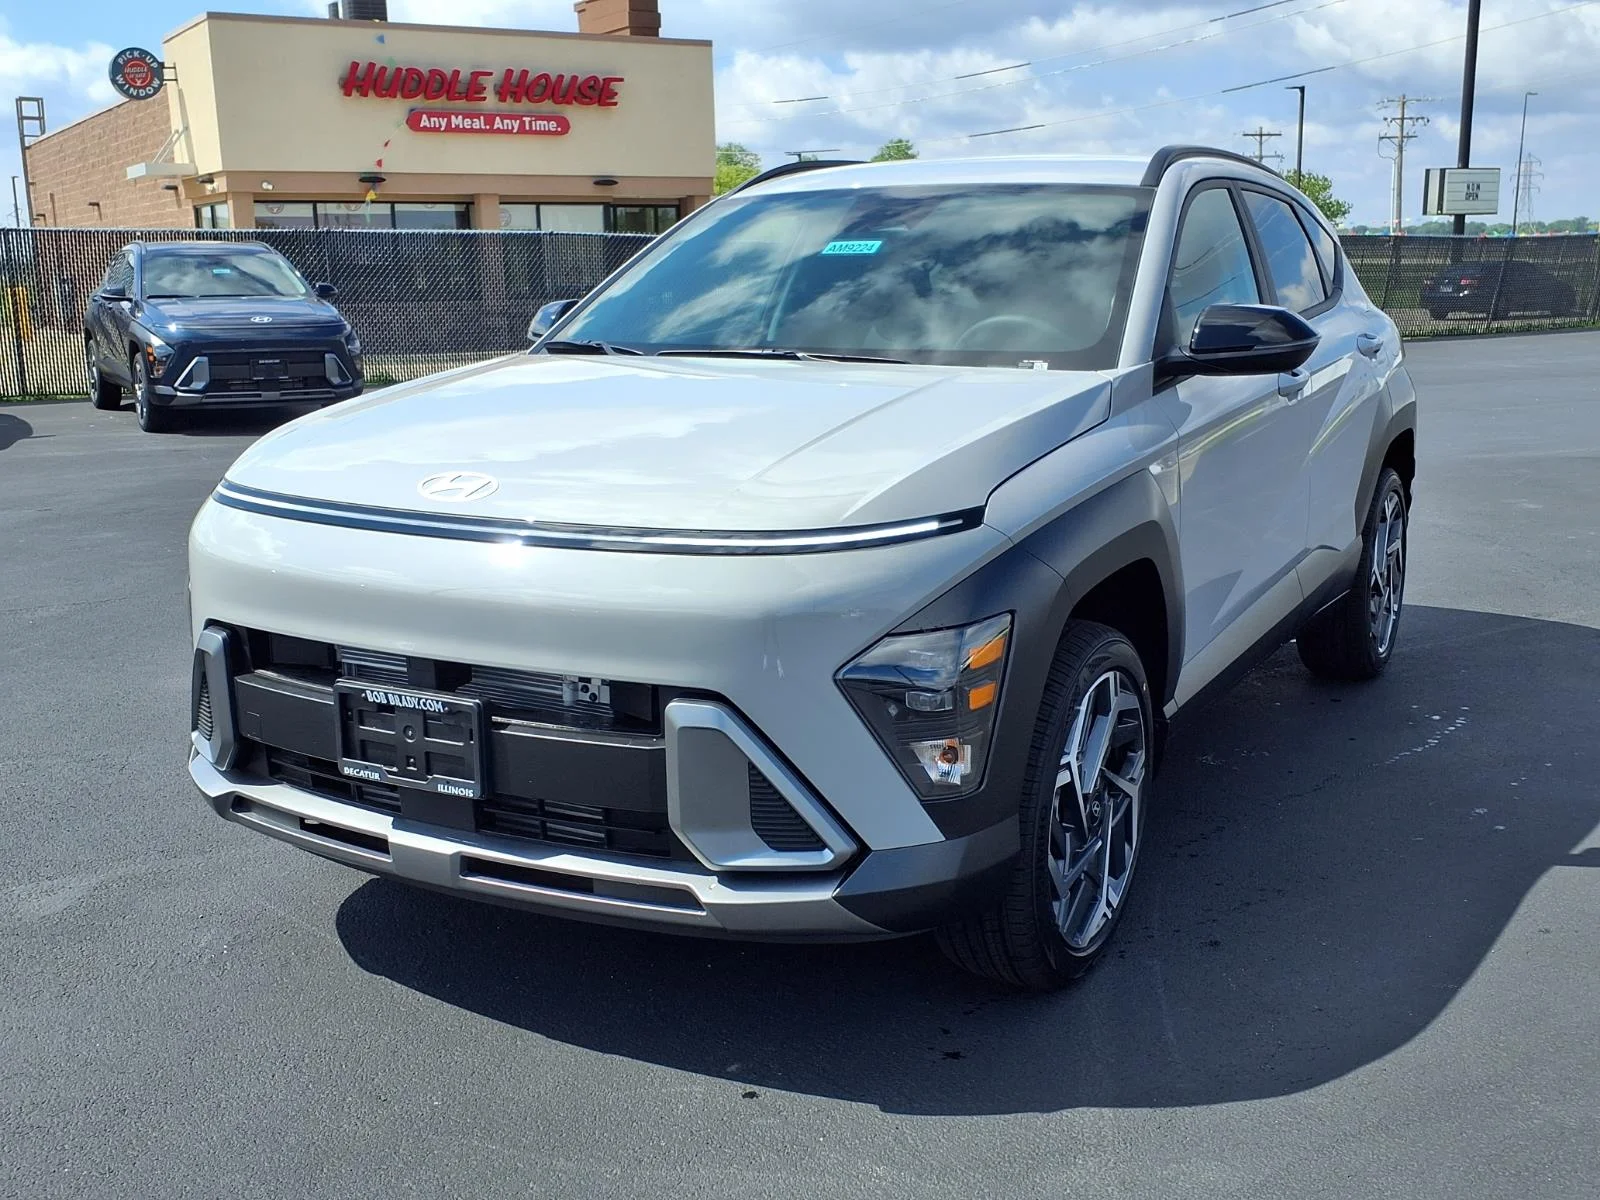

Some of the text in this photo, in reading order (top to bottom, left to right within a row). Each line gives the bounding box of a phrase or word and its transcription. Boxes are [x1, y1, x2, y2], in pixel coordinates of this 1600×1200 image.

[116, 74, 161, 97] WINDOW
[343, 61, 624, 106] HUDDLE HOUSE
[420, 114, 561, 133] Any Meal. Any Time.
[826, 243, 875, 252] AM9224
[366, 690, 444, 713] BOB BRADY.COM
[344, 766, 381, 781] DECATUR
[437, 784, 474, 798] ILLINOIS
